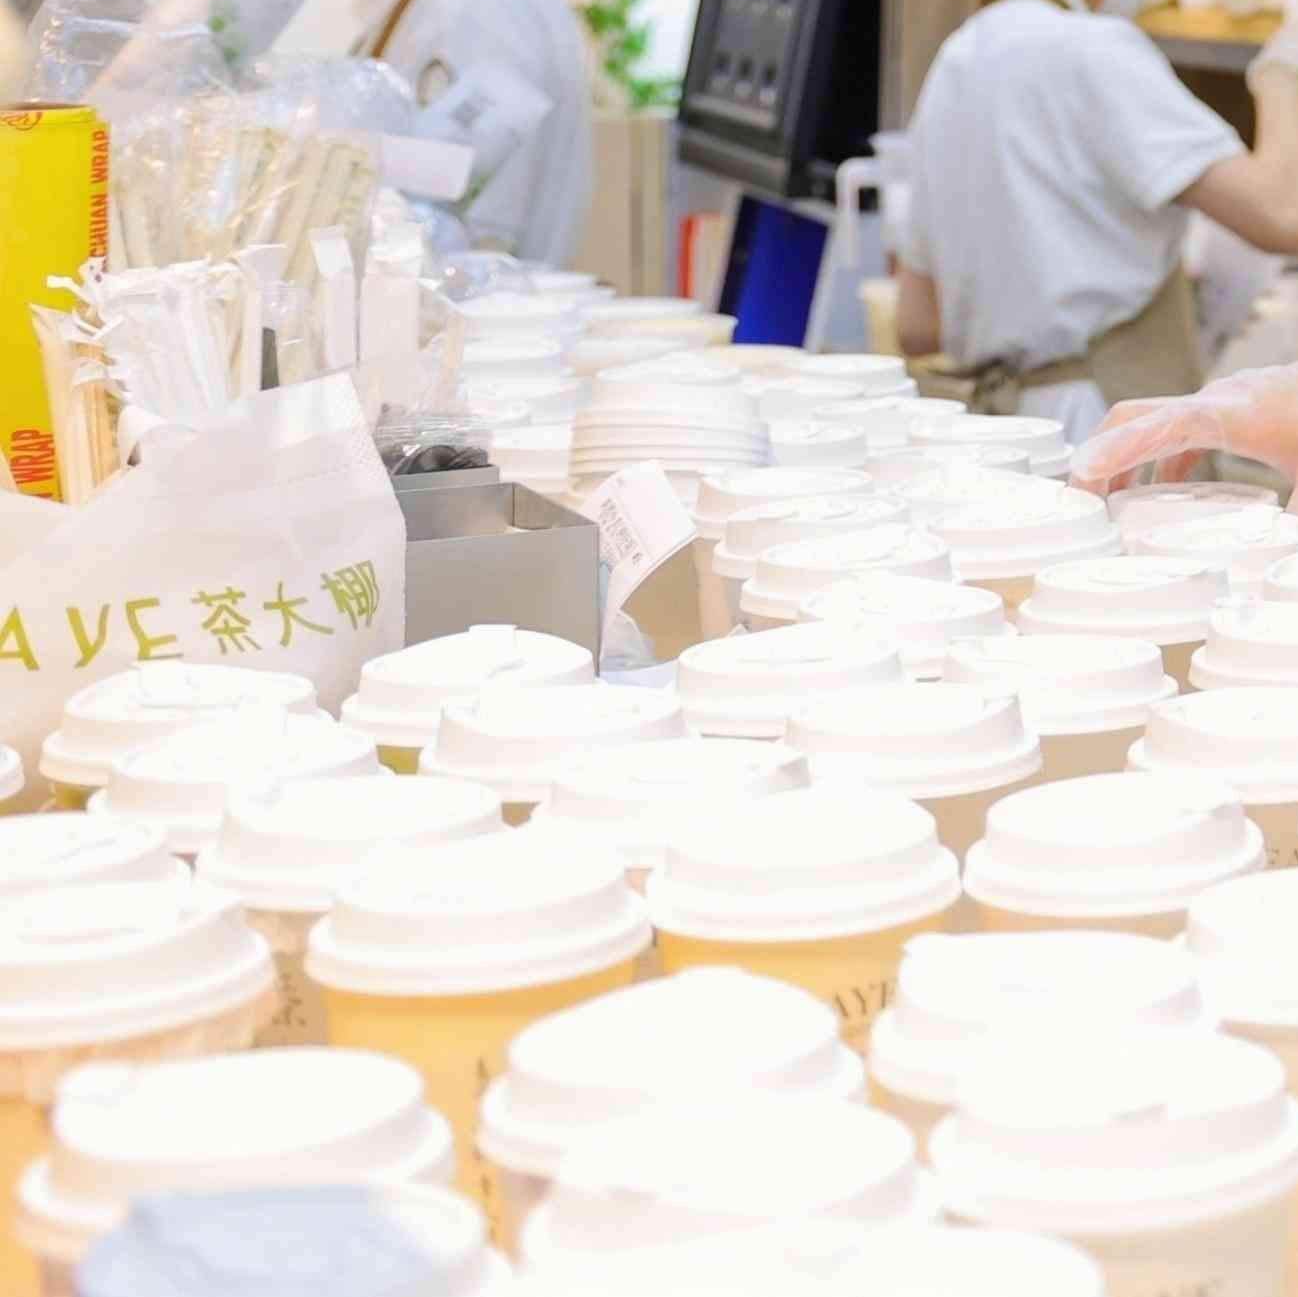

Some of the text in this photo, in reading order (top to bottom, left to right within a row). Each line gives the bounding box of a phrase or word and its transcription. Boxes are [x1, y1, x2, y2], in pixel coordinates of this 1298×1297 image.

[90, 130, 109, 184] WRAP
[10, 429, 55, 484] WRAP
[190, 560, 380, 654] 茶大椰
